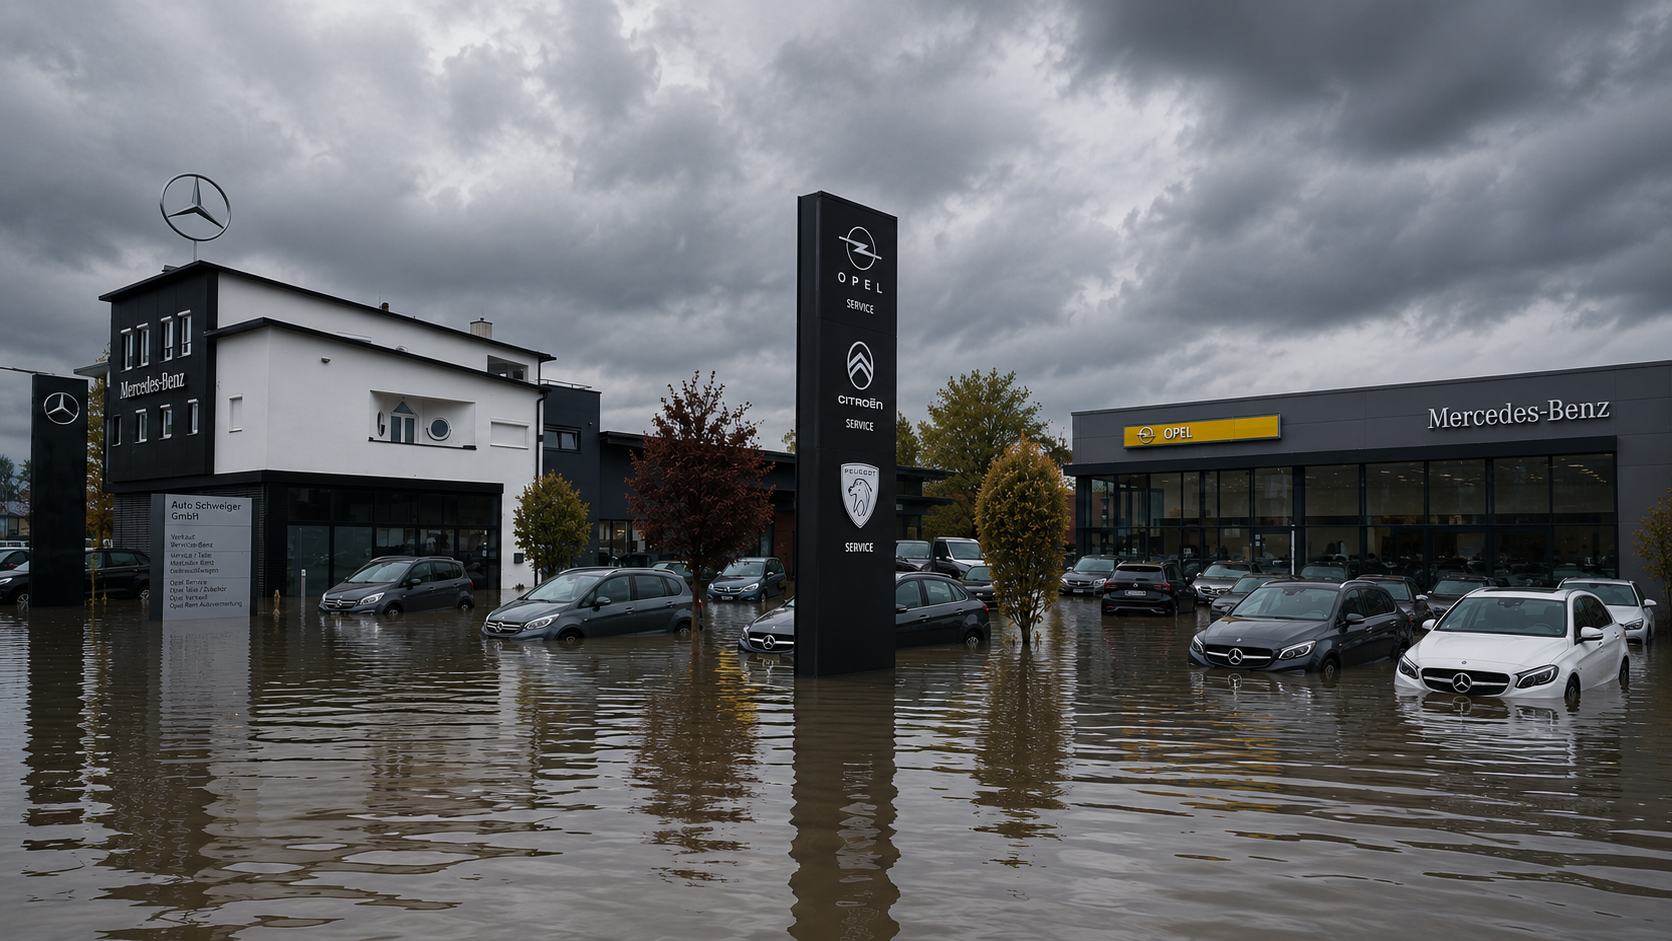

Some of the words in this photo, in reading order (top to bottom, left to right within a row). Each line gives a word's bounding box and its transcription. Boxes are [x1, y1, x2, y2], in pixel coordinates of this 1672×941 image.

[837, 271, 883, 294] OPEL
[846, 298, 874, 315] SERVICE
[119, 372, 185, 399] Mercedes-Benz
[1427, 399, 1610, 429] Mercedes-Benz
[845, 418, 874, 432] SERVICE
[1163, 426, 1193, 440] OPEL
[171, 501, 193, 510] Auto
[195, 501, 241, 512] Schweiger
[171, 512, 199, 520] GmbH
[845, 542, 874, 553] SERVICE
